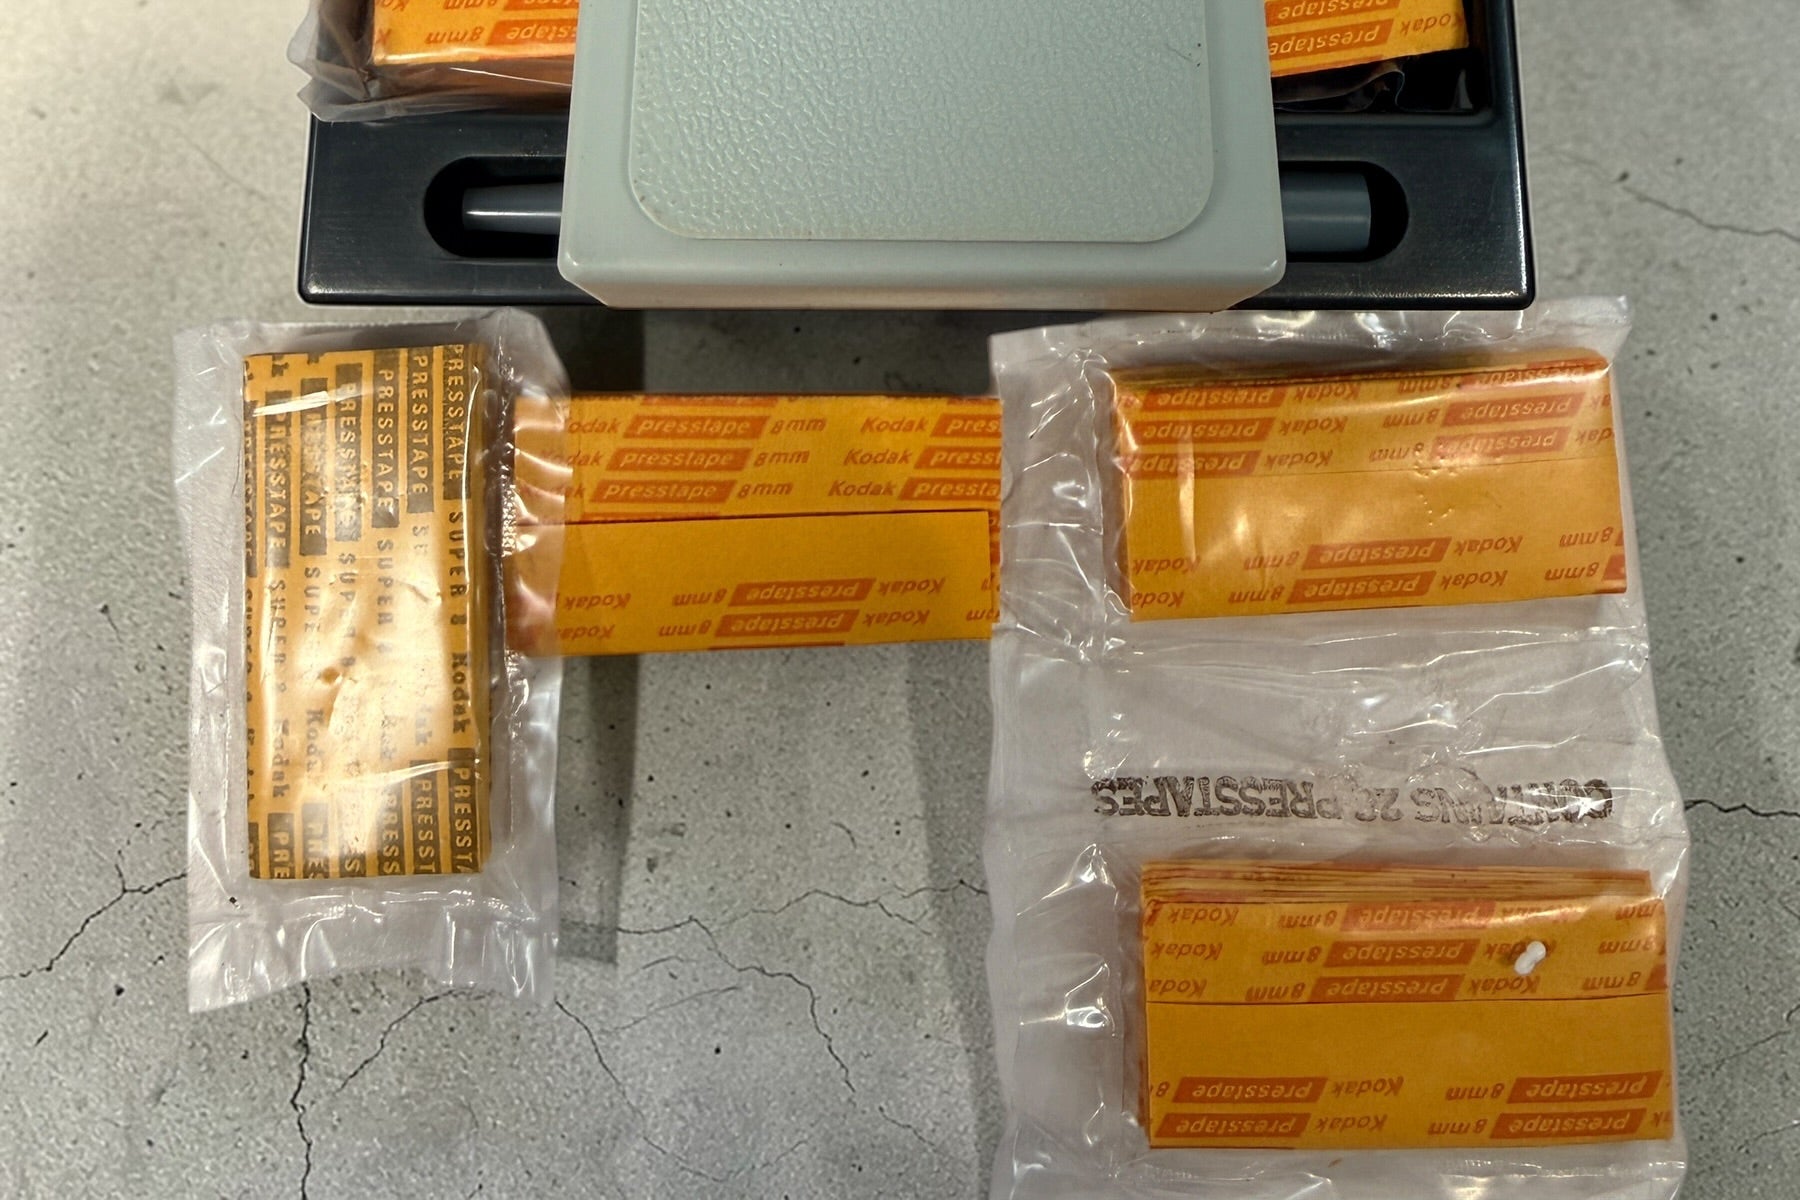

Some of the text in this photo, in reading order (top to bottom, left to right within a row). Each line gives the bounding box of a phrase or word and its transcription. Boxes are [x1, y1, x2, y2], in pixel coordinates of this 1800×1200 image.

[425, 27, 486, 44] 8mm
[1270, 25, 1379, 56] presstape
[1157, 388, 1273, 405] presstape
[448, 345, 465, 480] PRESSTAPE
[1383, 409, 1439, 428] 8mm
[1462, 399, 1572, 419] presstape
[411, 355, 428, 493] PRESSTAPE
[637, 418, 750, 436] presstape
[770, 417, 827, 435] 8mm
[860, 417, 929, 433] Kodak
[1144, 421, 1259, 438] presstape
[1280, 416, 1348, 435] Kodak
[377, 369, 394, 508] PRESSTAPE
[620, 451, 733, 468] presstape
[754, 449, 810, 467] 8mm
[843, 449, 913, 466] Kodak
[1266, 450, 1333, 468] Kodak
[604, 484, 717, 500] presstape
[737, 481, 793, 498] 8mm
[828, 481, 898, 497] Kodak
[449, 512, 468, 596] SUPER
[1132, 527, 1614, 575] 8mm Kodak presstape 8mm Kodak
[1441, 571, 1508, 590] Kodak
[1545, 562, 1600, 581] 8mm
[565, 578, 945, 610] Kodak presstape 8mm Kodak
[1228, 586, 1285, 604] 8mm
[1303, 575, 1420, 600] presstape
[658, 619, 712, 636] 8mm
[731, 613, 844, 633] presstape
[864, 610, 930, 627] Kodak
[451, 653, 470, 734] Kodak
[1091, 776, 1342, 820] PRESSTAPES
[1168, 906, 1239, 926] Kodak
[1279, 910, 1337, 928] 8mm
[1153, 942, 1223, 961] Kodak
[1261, 946, 1321, 965] 8mm
[1342, 942, 1464, 963] presstape
[1151, 972, 1641, 1001] 8mm Kodak presstape 8mm Koda
[1192, 1083, 1312, 1101] presstape
[1333, 1076, 1404, 1097] Kodak
[1445, 1083, 1504, 1100] 8mm
[1526, 1077, 1647, 1098] presstape
[1176, 1113, 1630, 1135] presstape 8mm Kodak presstape
